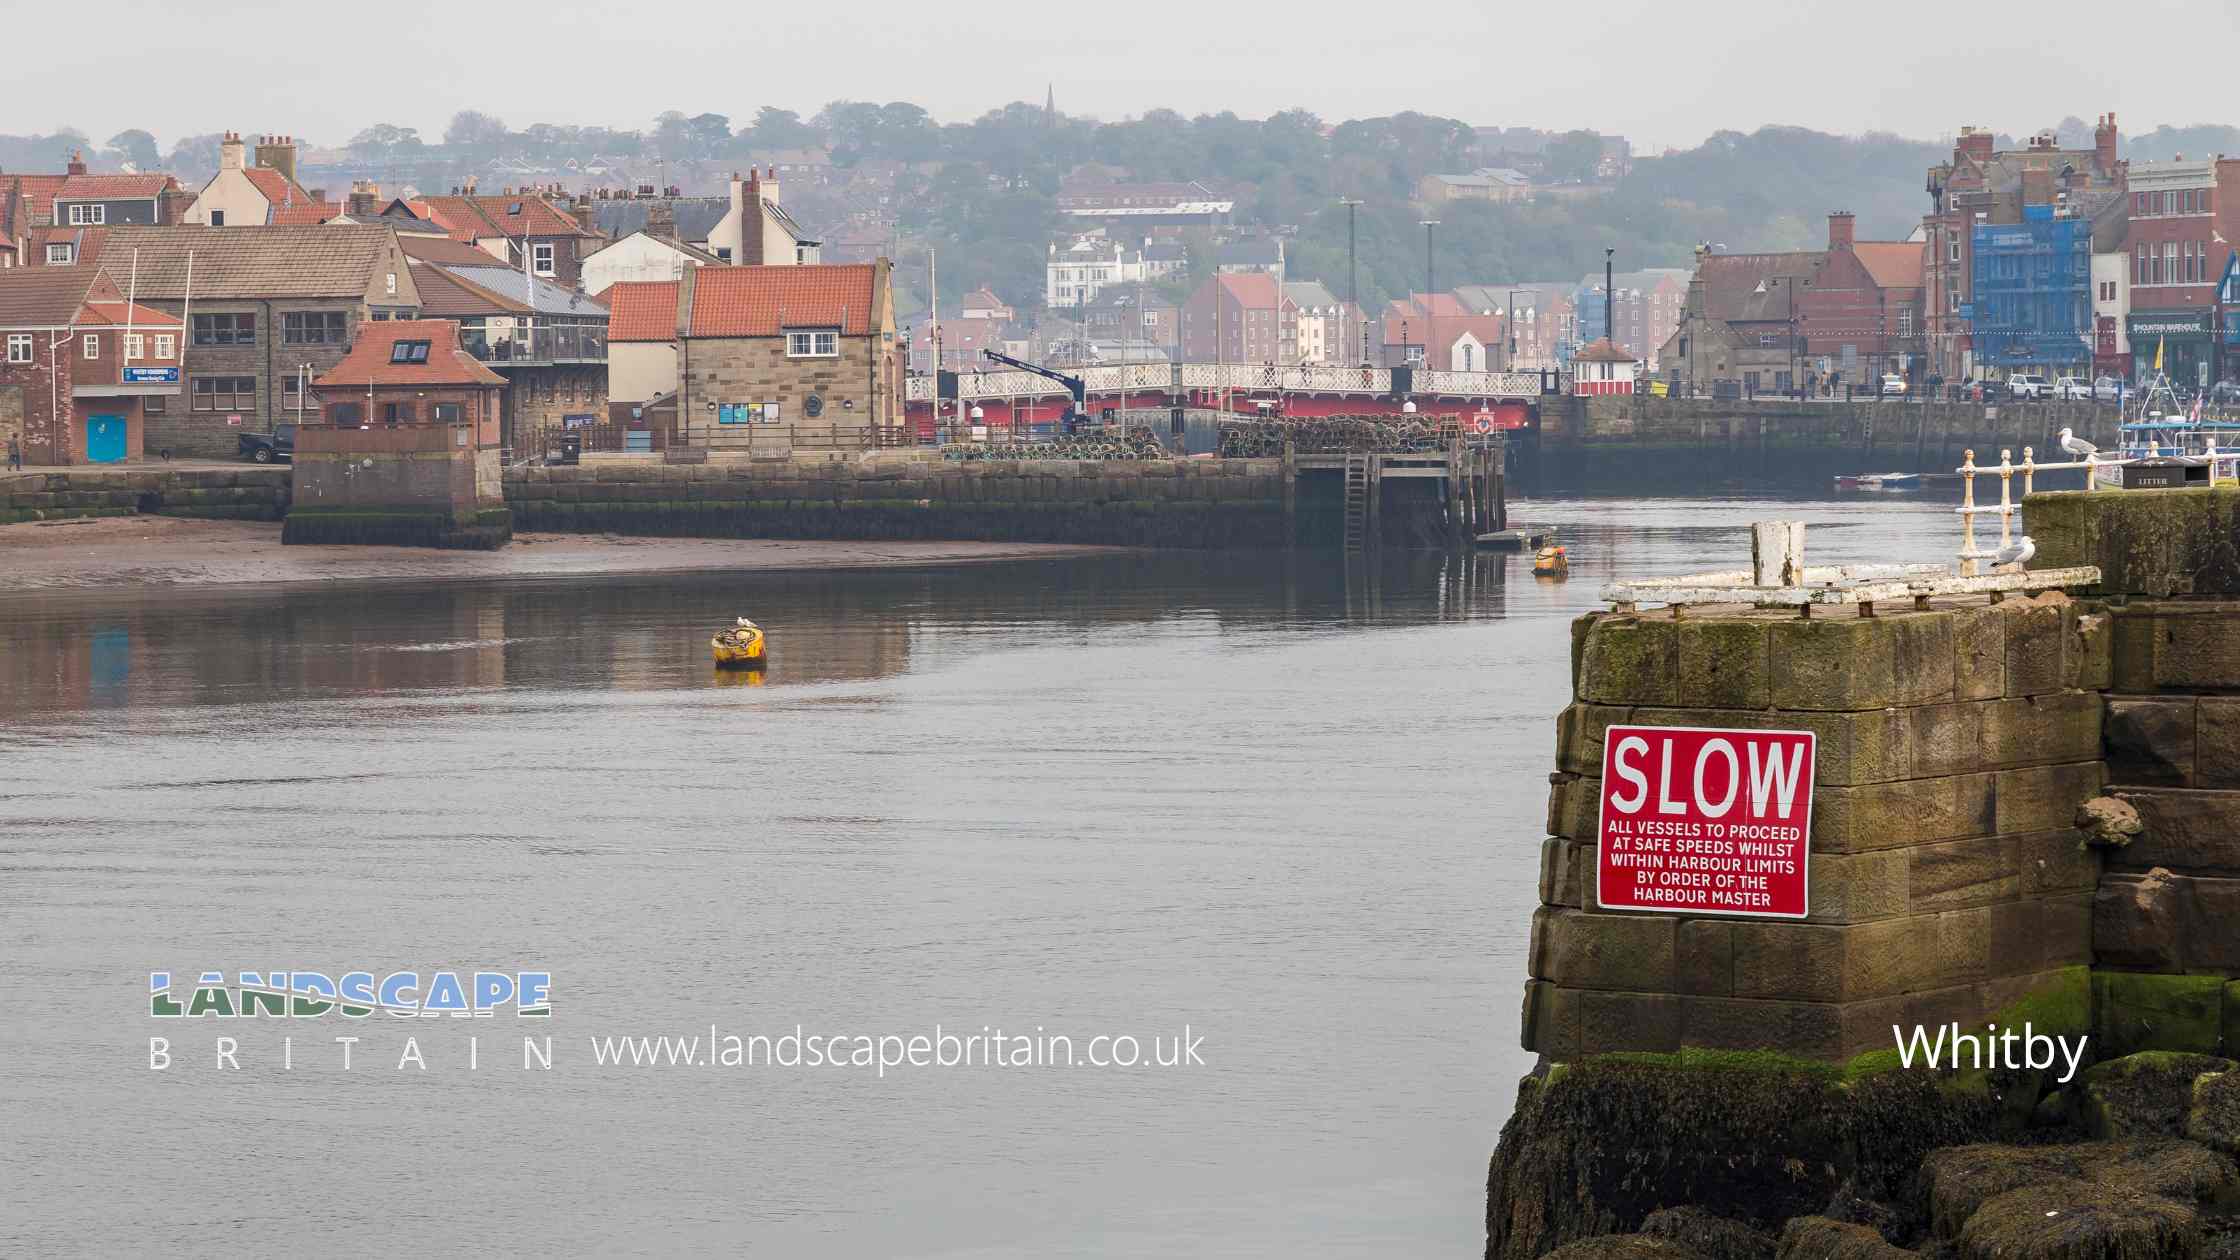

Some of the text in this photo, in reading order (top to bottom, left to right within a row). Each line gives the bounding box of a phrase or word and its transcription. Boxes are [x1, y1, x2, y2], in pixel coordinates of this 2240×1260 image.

[2138, 478, 2168, 486] LITTER
[1610, 736, 1805, 819] SLOW
[1608, 820, 1800, 841] ALL VESSELS TO PROCEED
[1612, 836, 1795, 857] AT SAFE SPEEDS WHILST
[1610, 853, 1795, 874] WITHIN HARBOUR LIMITS
[1636, 870, 1768, 890] BY ORDER OF THE
[1633, 887, 1771, 907] HARBOUR MASTER
